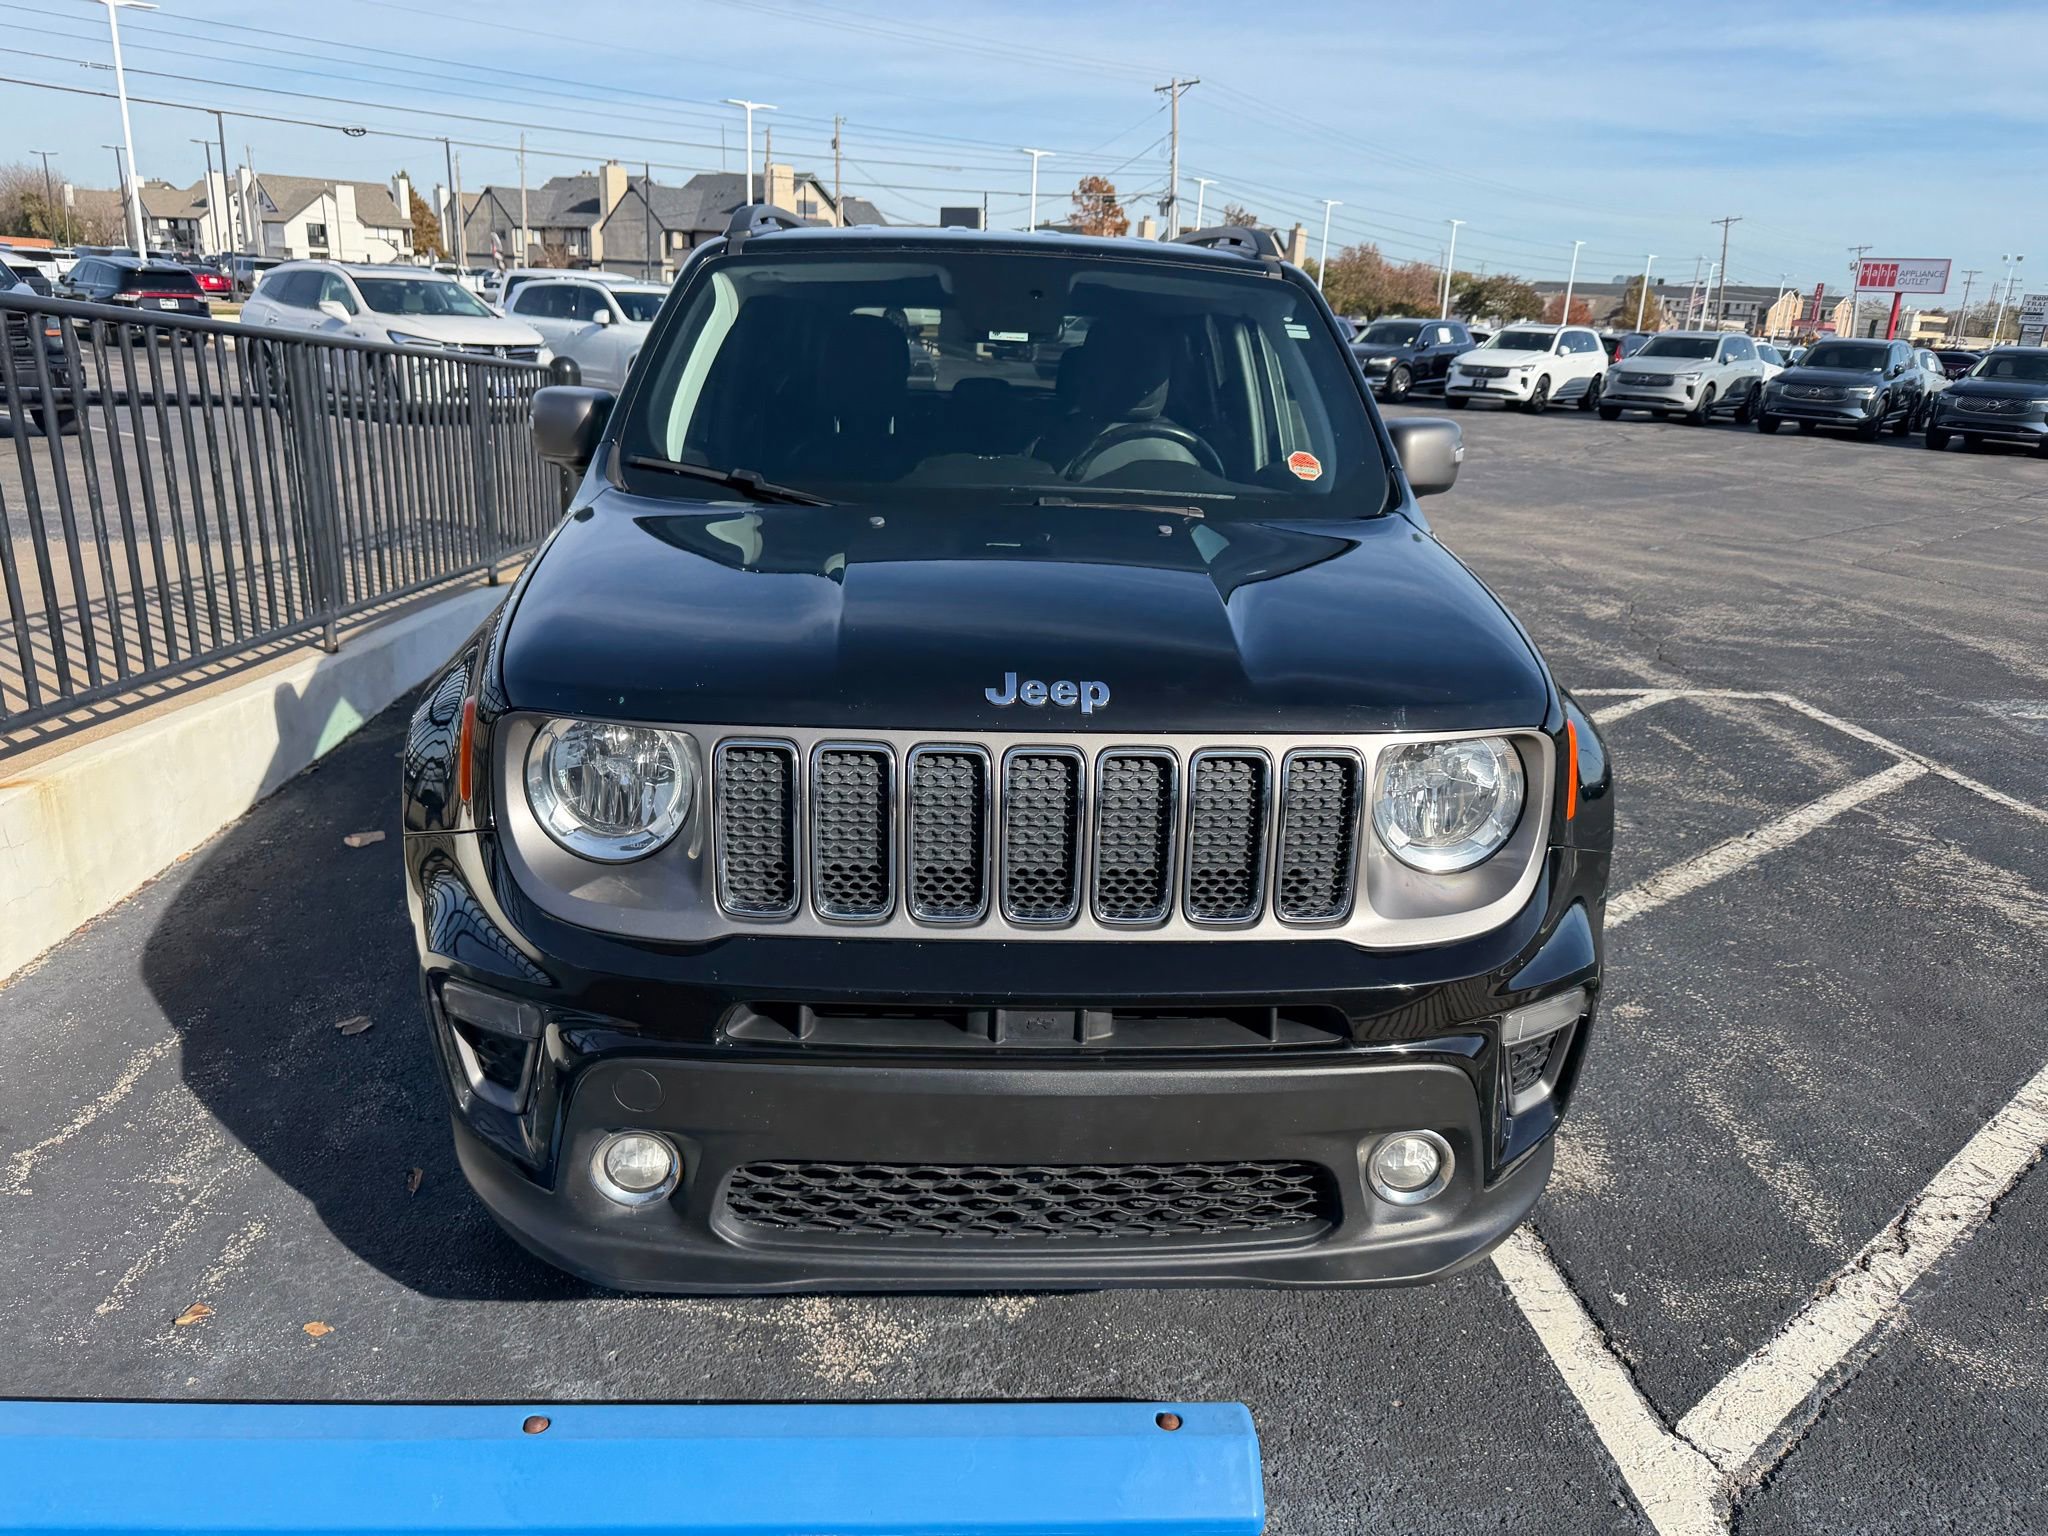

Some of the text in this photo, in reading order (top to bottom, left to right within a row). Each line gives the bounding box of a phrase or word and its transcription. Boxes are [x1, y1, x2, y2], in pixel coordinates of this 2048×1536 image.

[1862, 267, 1897, 277] Hahn
[1899, 270, 1945, 278] APPLIANCE
[984, 671, 1111, 715] Jeep
